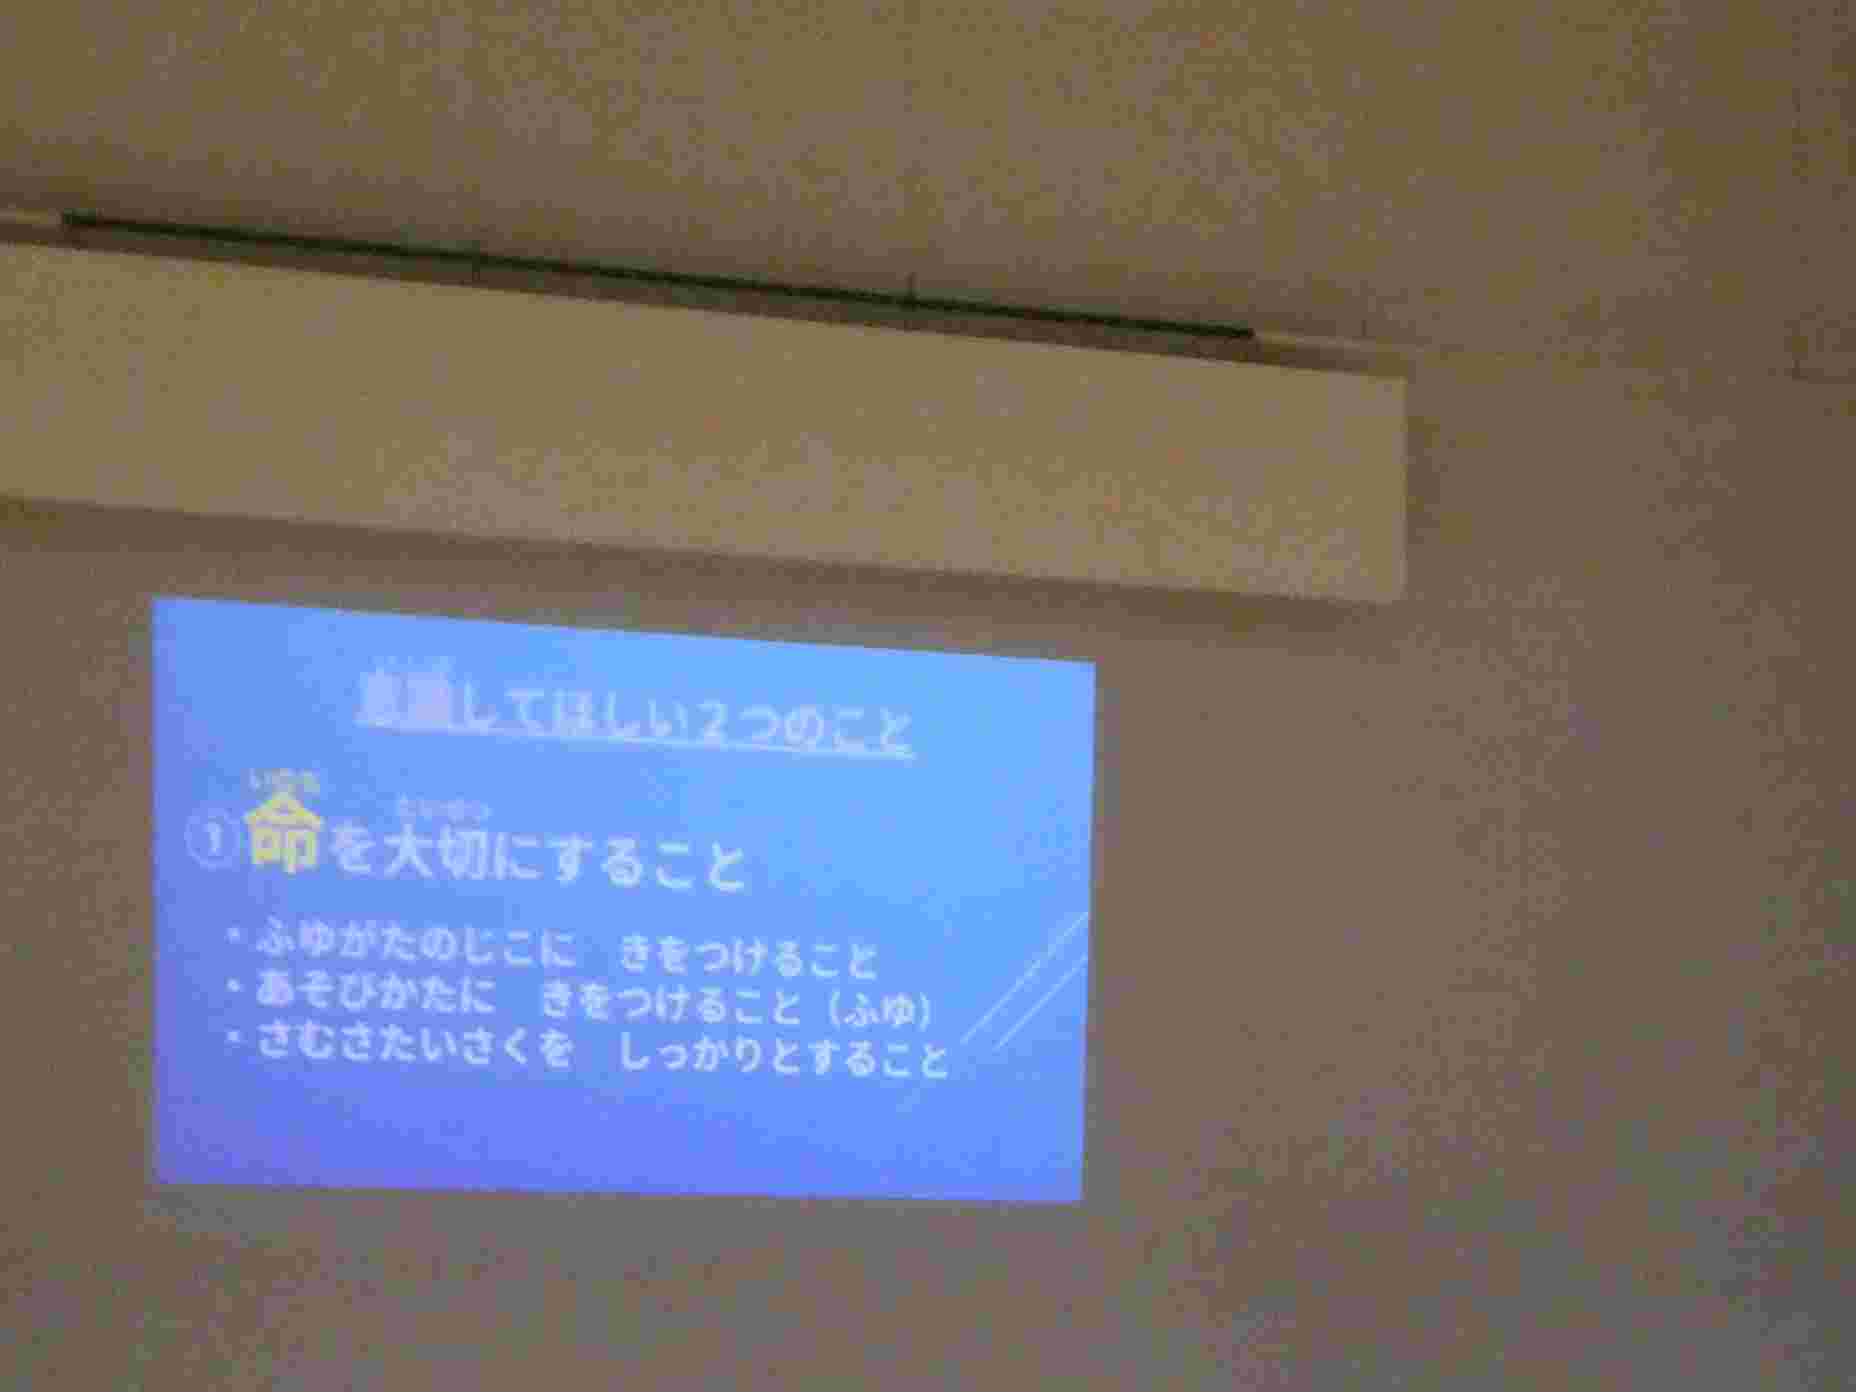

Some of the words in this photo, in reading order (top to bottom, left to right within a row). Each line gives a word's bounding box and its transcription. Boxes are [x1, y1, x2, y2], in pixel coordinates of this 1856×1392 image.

[620, 932, 877, 980] きをつけること
[620, 1032, 949, 1080] しっかりとすること
